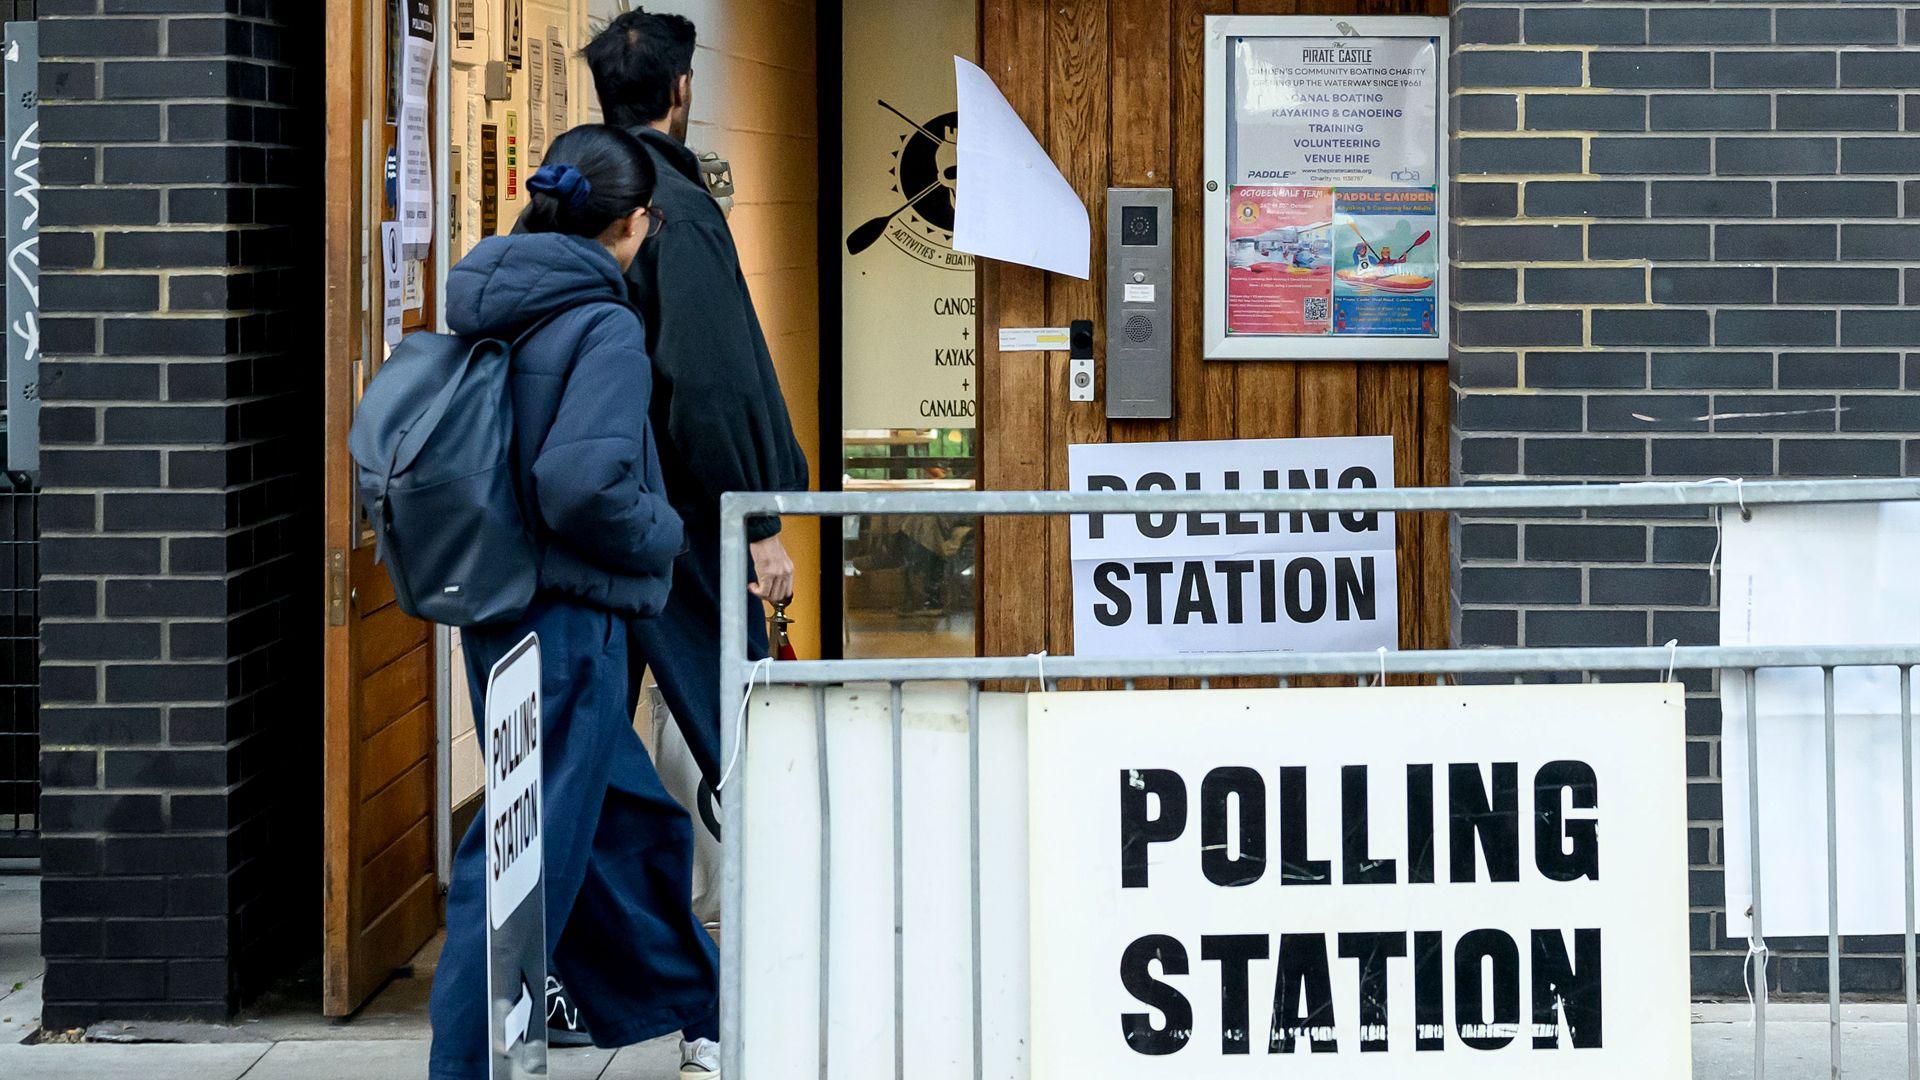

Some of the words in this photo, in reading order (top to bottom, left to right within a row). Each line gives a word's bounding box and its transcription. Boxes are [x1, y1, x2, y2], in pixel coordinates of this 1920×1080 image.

[1302, 49, 1334, 63] PIRATE
[1338, 49, 1372, 63] CASTLE
[1293, 79, 1305, 87] UP
[1307, 79, 1322, 87] THE
[1323, 79, 1372, 87] WATERWAY
[1373, 79, 1399, 87] SINCE
[1332, 94, 1384, 103] BOATING
[1272, 109, 1330, 118] KAYAKING
[1332, 109, 1340, 118] &
[1342, 109, 1403, 118] CANOEING
[1308, 124, 1364, 133] TRAINING
[1293, 139, 1381, 148] VOLUNTEERING
[1304, 154, 1342, 163] VENUE
[1344, 154, 1370, 163] HIRE
[1247, 170, 1290, 179] PADDLE
[1240, 188, 1277, 198] OCTOBER
[1302, 189, 1324, 199] TERM
[1335, 191, 1382, 202] PADDLE
[1384, 191, 1434, 202] CAMDEN
[892, 229, 935, 259] ACTIVITIES
[1087, 466, 1379, 539] POLLING
[1093, 556, 1377, 627] STATION
[493, 691, 537, 789] POLLING
[1120, 760, 1600, 888] POLLING
[493, 783, 538, 881] STATION
[1120, 928, 1603, 1056] STATION
